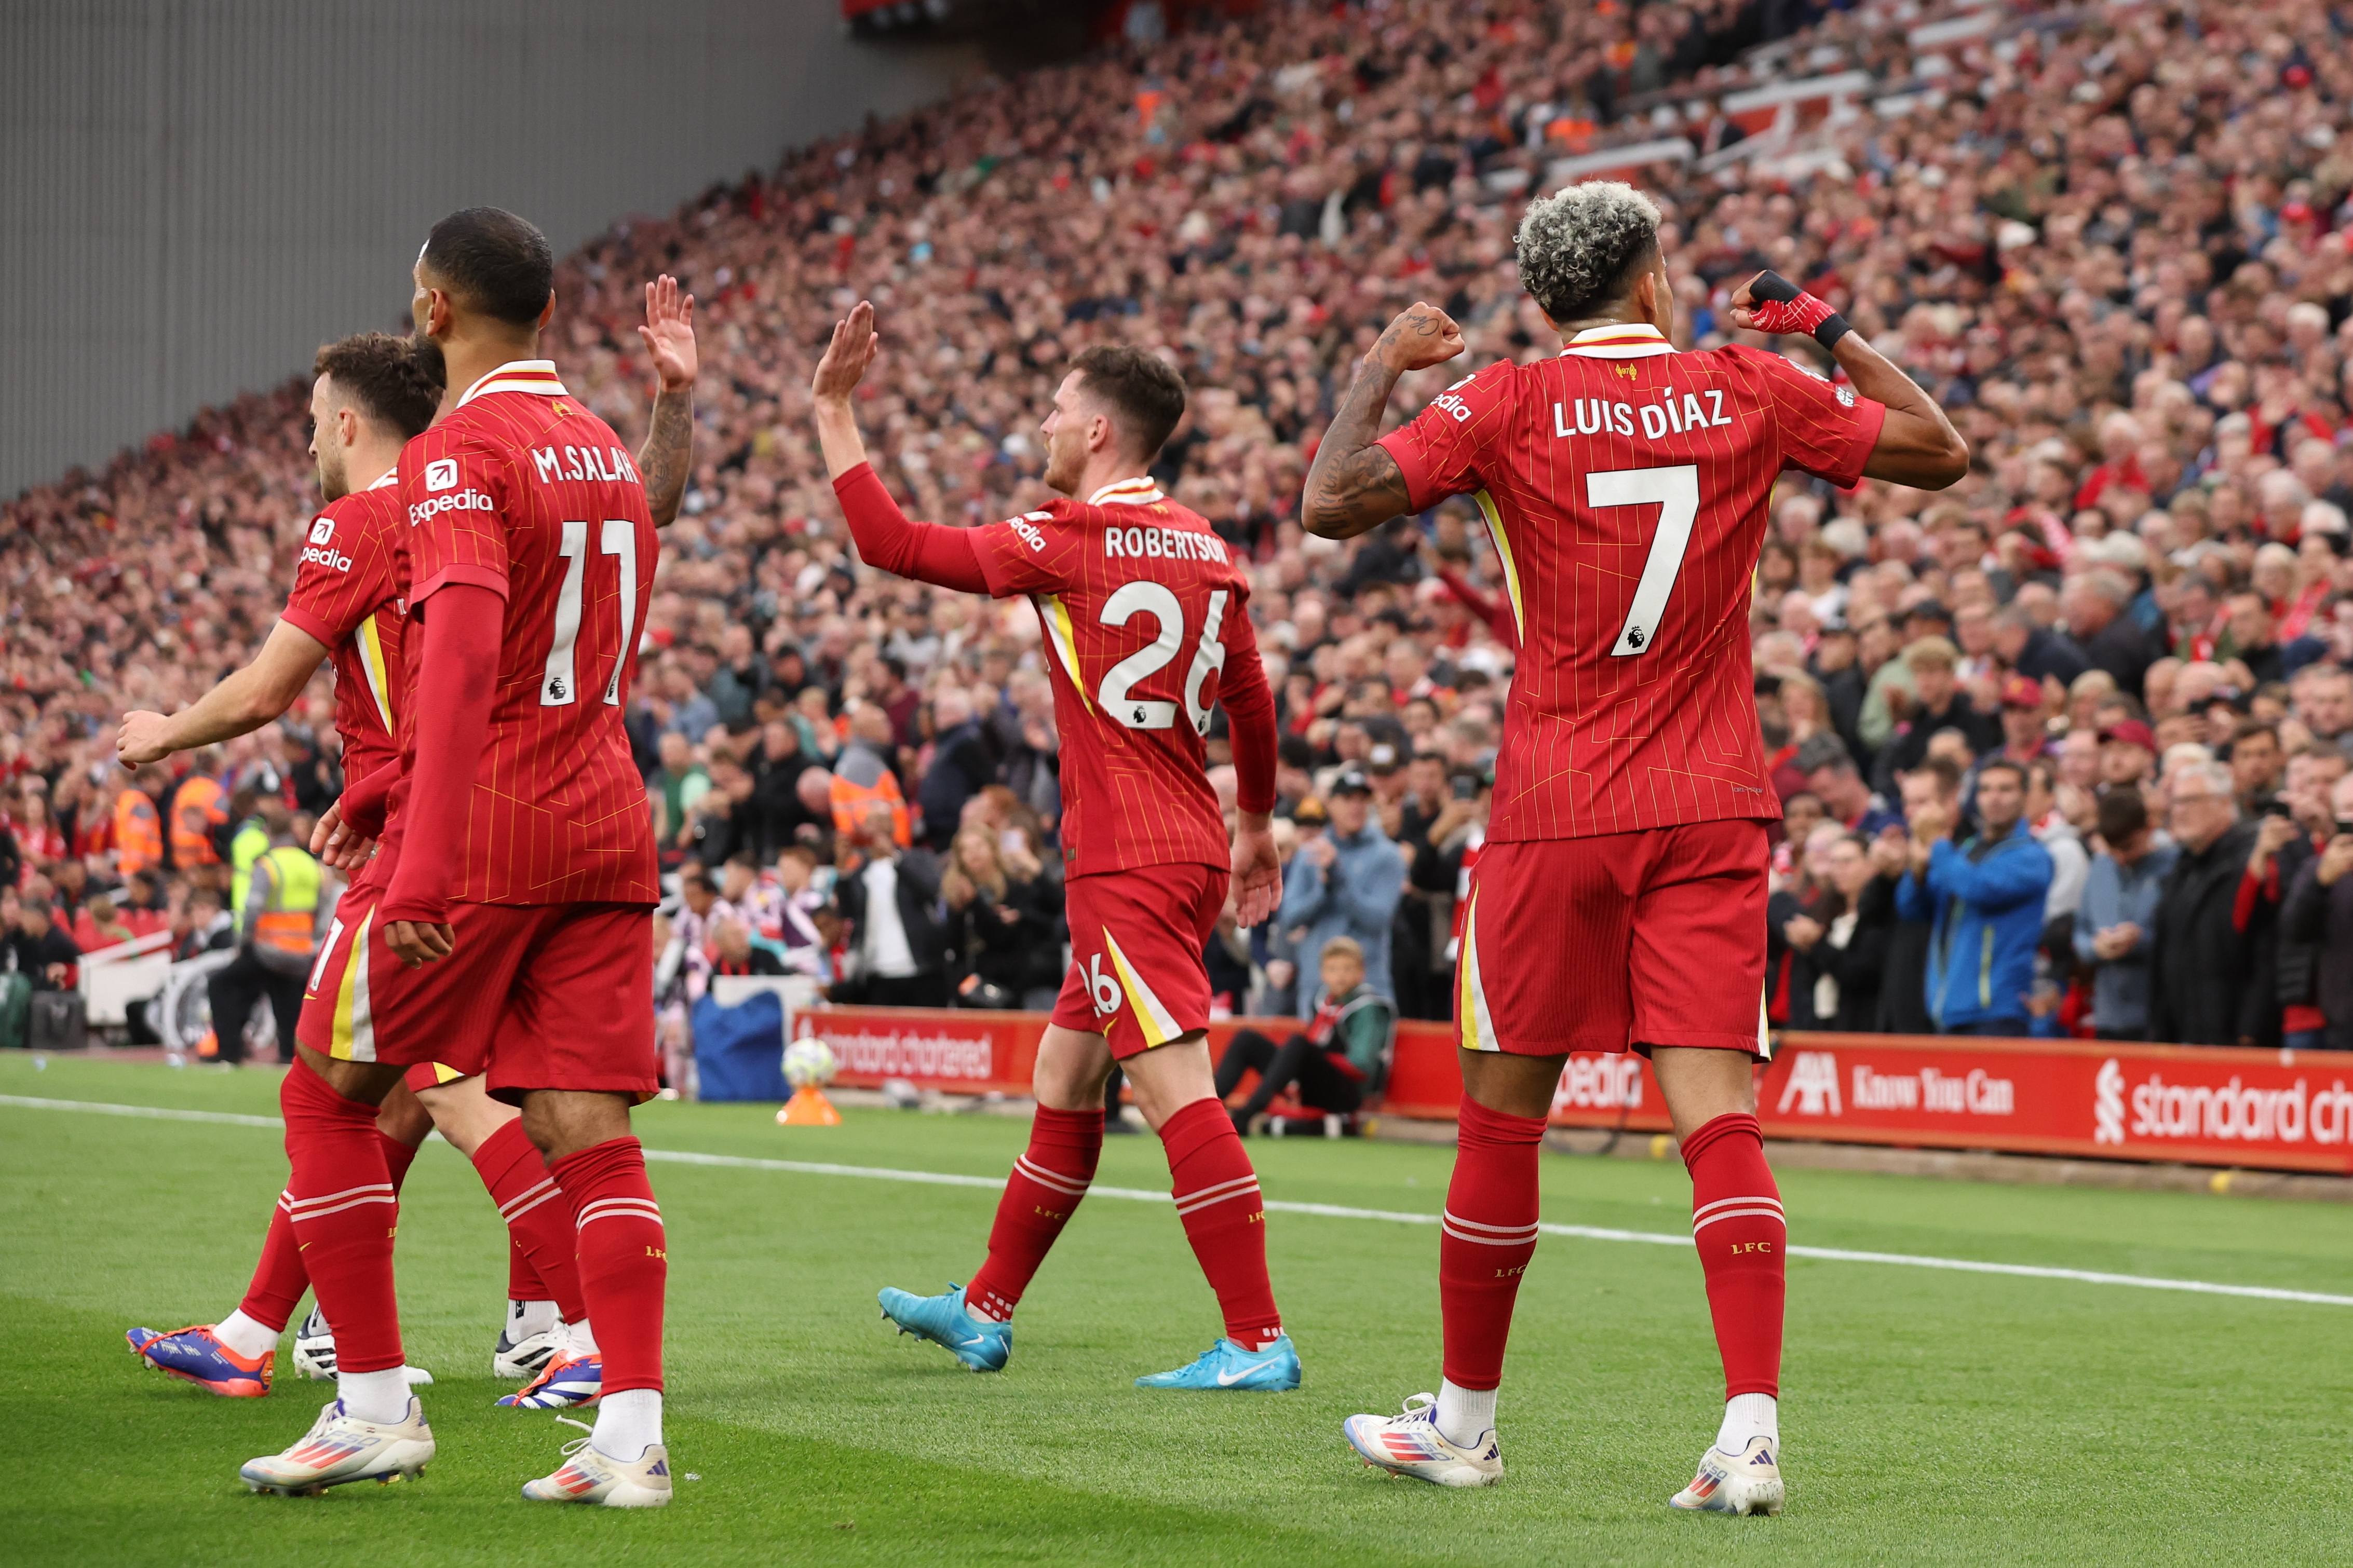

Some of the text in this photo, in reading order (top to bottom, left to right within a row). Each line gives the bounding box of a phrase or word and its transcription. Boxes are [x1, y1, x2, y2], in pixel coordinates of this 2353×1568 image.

[1430, 393, 1472, 422] edia
[1554, 386, 1733, 440] LUIS DÍAZ
[531, 445, 640, 484] M.SALAH
[408, 488, 494, 527] Expedia
[1006, 516, 1047, 553] edia
[1105, 527, 1229, 566] ROBERTSON
[300, 546, 353, 574] pedia
[1586, 464, 1700, 657] 7
[539, 520, 637, 706] 11
[1098, 580, 1228, 738] 26
[817, 1025, 900, 1075] andard
[1551, 1053, 1643, 1116] pedia
[1851, 1064, 2016, 1116] Know You Can
[2131, 1072, 2308, 1142] standard
[1730, 1242, 1771, 1255] LFC
[1494, 1264, 1526, 1277] LFC
[1706, 1461, 1728, 1479] F50
